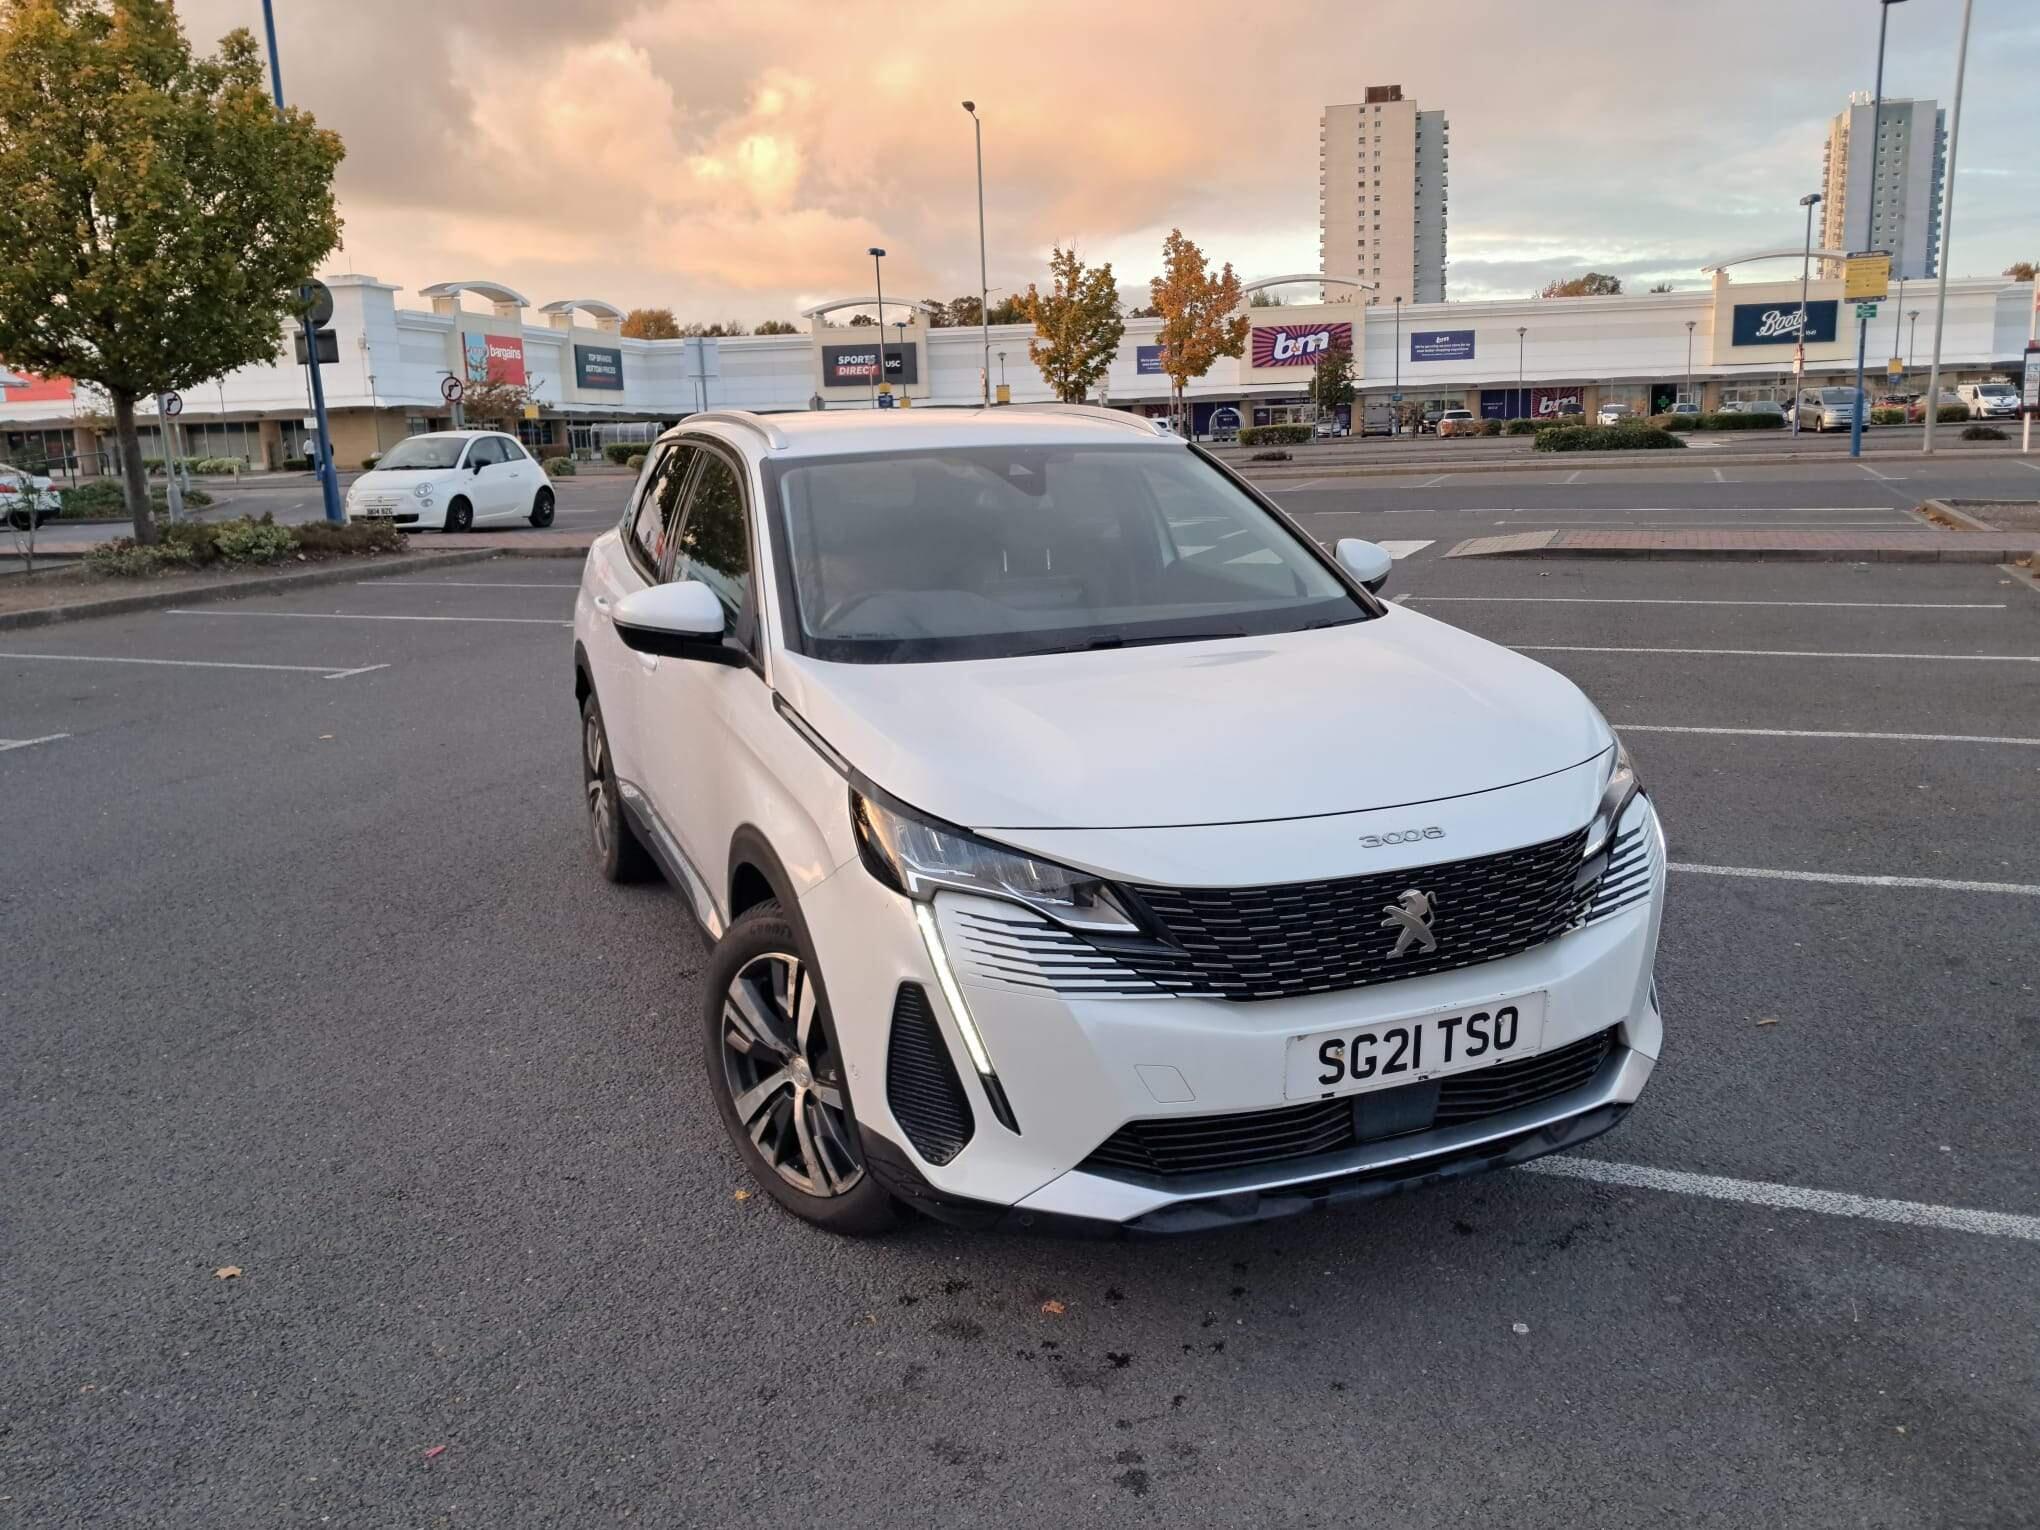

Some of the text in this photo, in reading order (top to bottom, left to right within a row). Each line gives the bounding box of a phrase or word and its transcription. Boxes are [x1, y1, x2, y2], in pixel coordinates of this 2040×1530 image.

[490, 344, 522, 361] bargains
[838, 355, 876, 365] SPORTS
[839, 366, 876, 376] DIRECT
[1318, 1006, 1519, 1085] SG21 TSO
